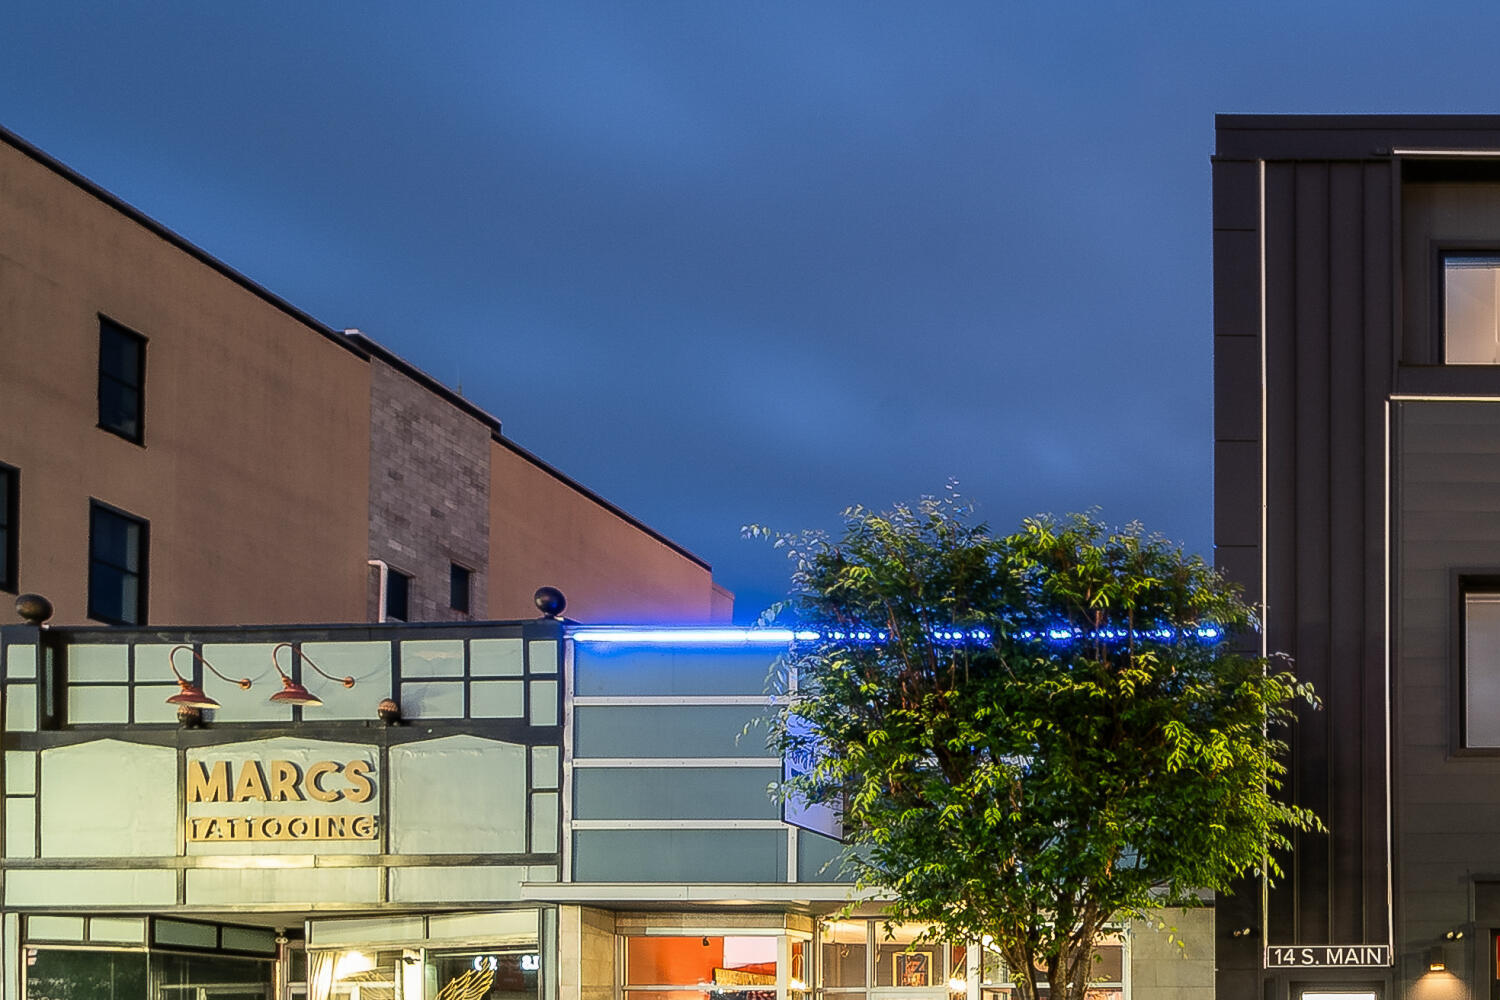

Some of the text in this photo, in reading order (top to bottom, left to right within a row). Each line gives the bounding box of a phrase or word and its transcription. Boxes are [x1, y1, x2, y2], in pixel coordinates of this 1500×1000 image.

[188, 760, 378, 803] MARCS
[191, 817, 378, 839] TATTOOING
[898, 954, 926, 974] 12
[1275, 948, 1381, 965] 14 S. MAIN
